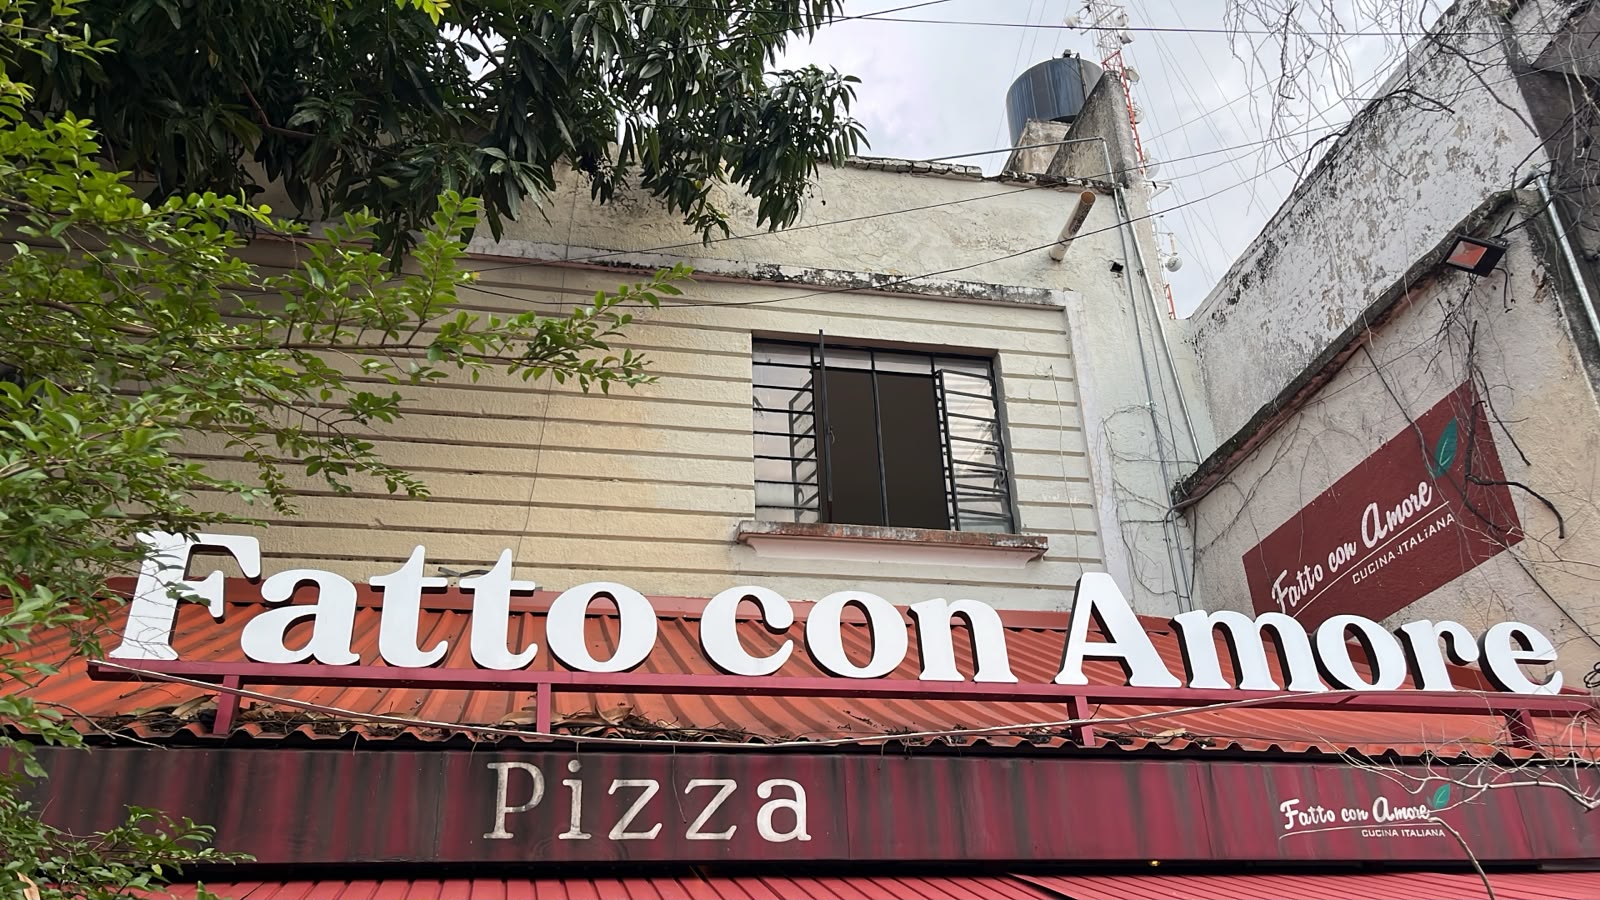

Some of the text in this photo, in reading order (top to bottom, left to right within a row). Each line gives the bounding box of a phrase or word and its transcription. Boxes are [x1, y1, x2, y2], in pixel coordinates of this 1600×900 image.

[1271, 481, 1433, 615] Fatto con Amore
[1352, 551, 1396, 585] CUCINA
[108, 530, 1563, 695] Fatto con Amore
[483, 759, 812, 843] Pizza
[1280, 796, 1431, 830] Fatto con Amore
[1361, 829, 1447, 838] CUCINA ITALIANA
